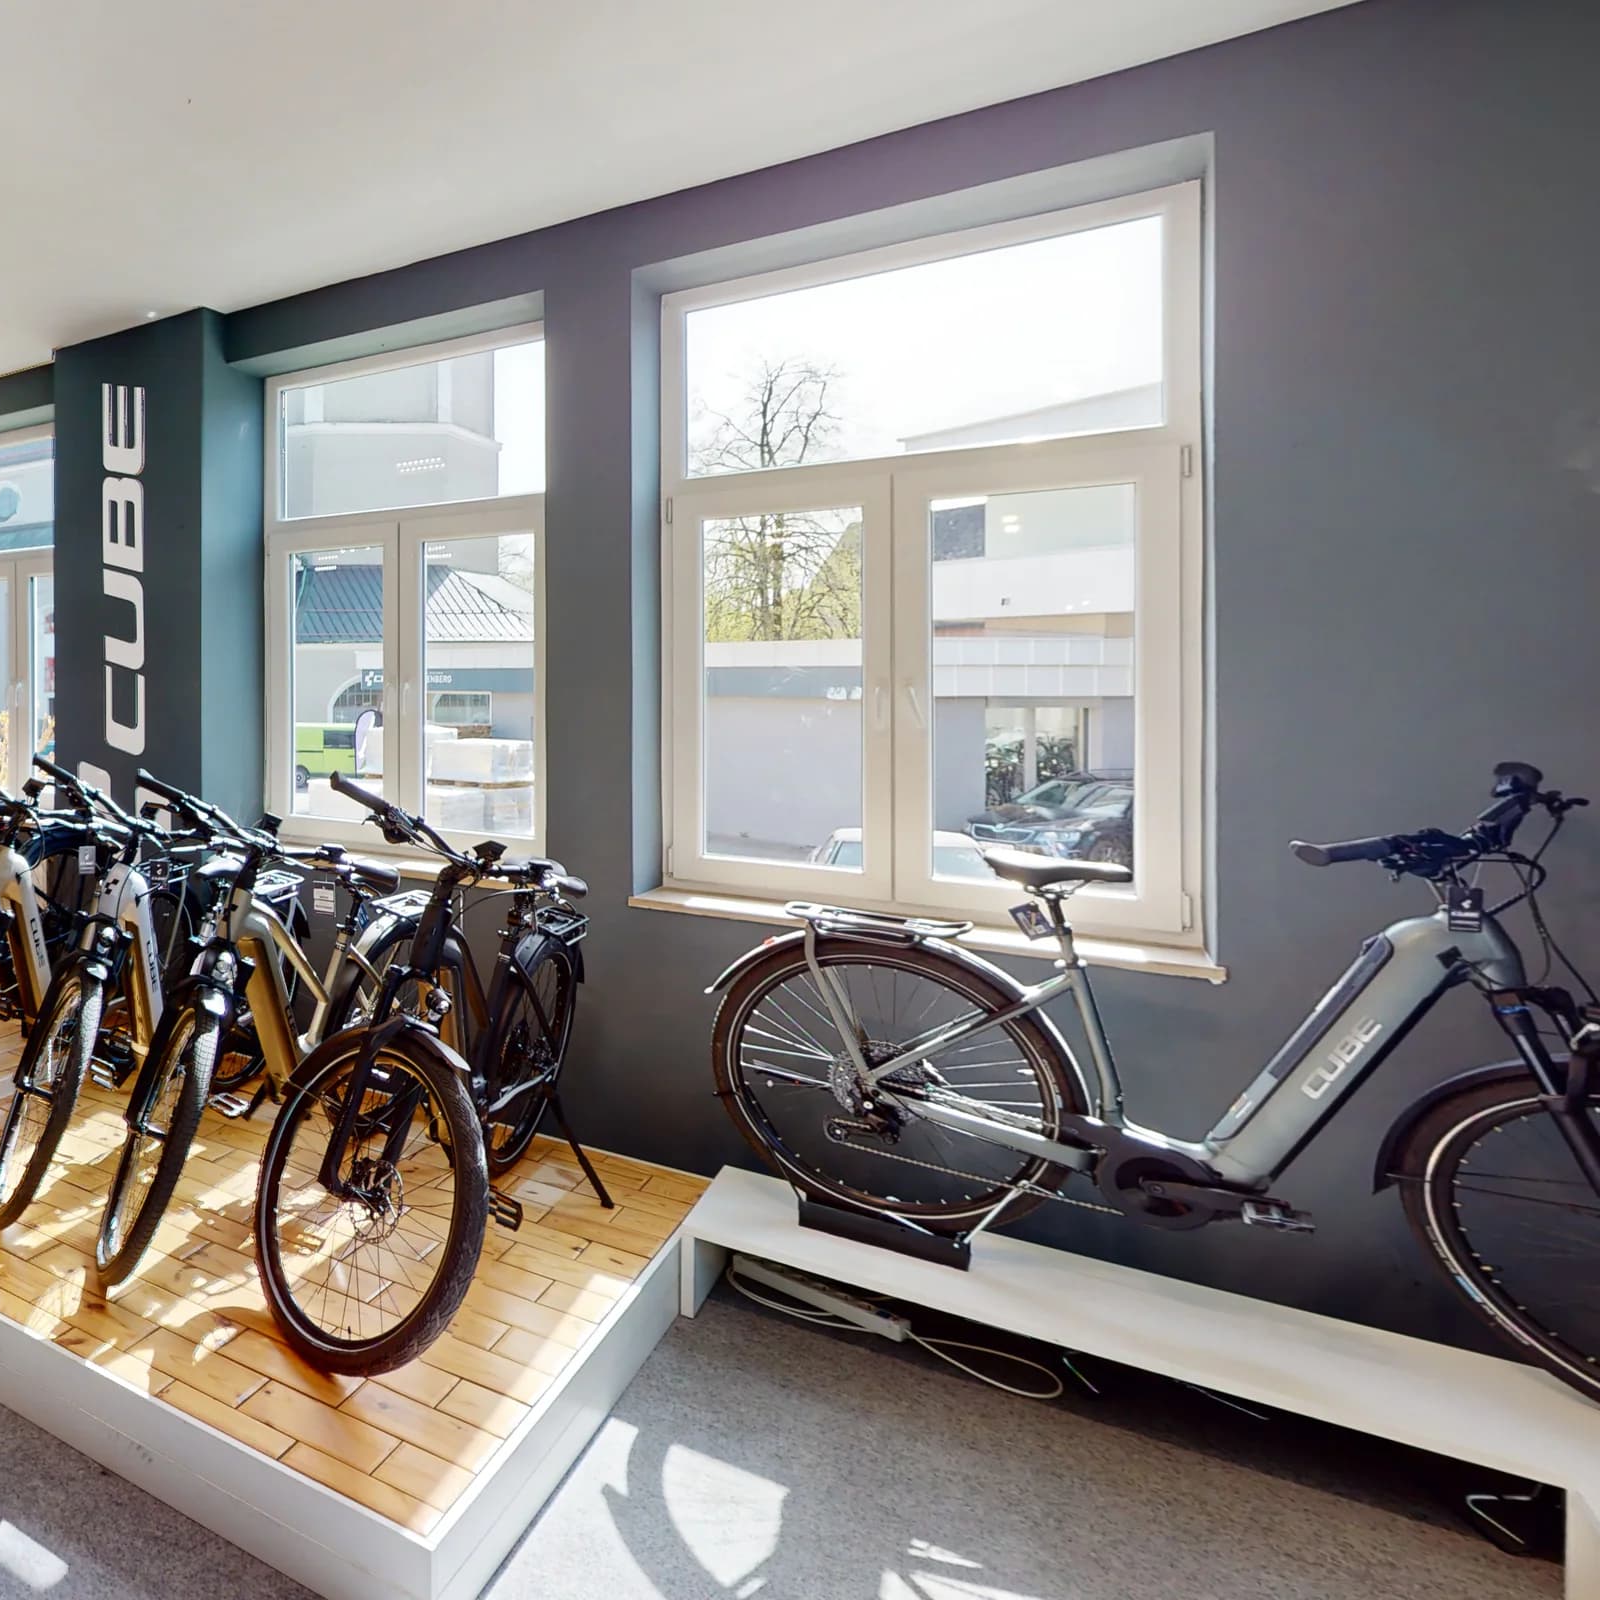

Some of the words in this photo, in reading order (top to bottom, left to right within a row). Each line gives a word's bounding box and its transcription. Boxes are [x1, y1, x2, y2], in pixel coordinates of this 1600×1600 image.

[102, 382, 145, 757] CUBE
[30, 917, 47, 969] CUBE
[146, 940, 160, 993] CUBE
[1300, 1016, 1383, 1100] CUBE
